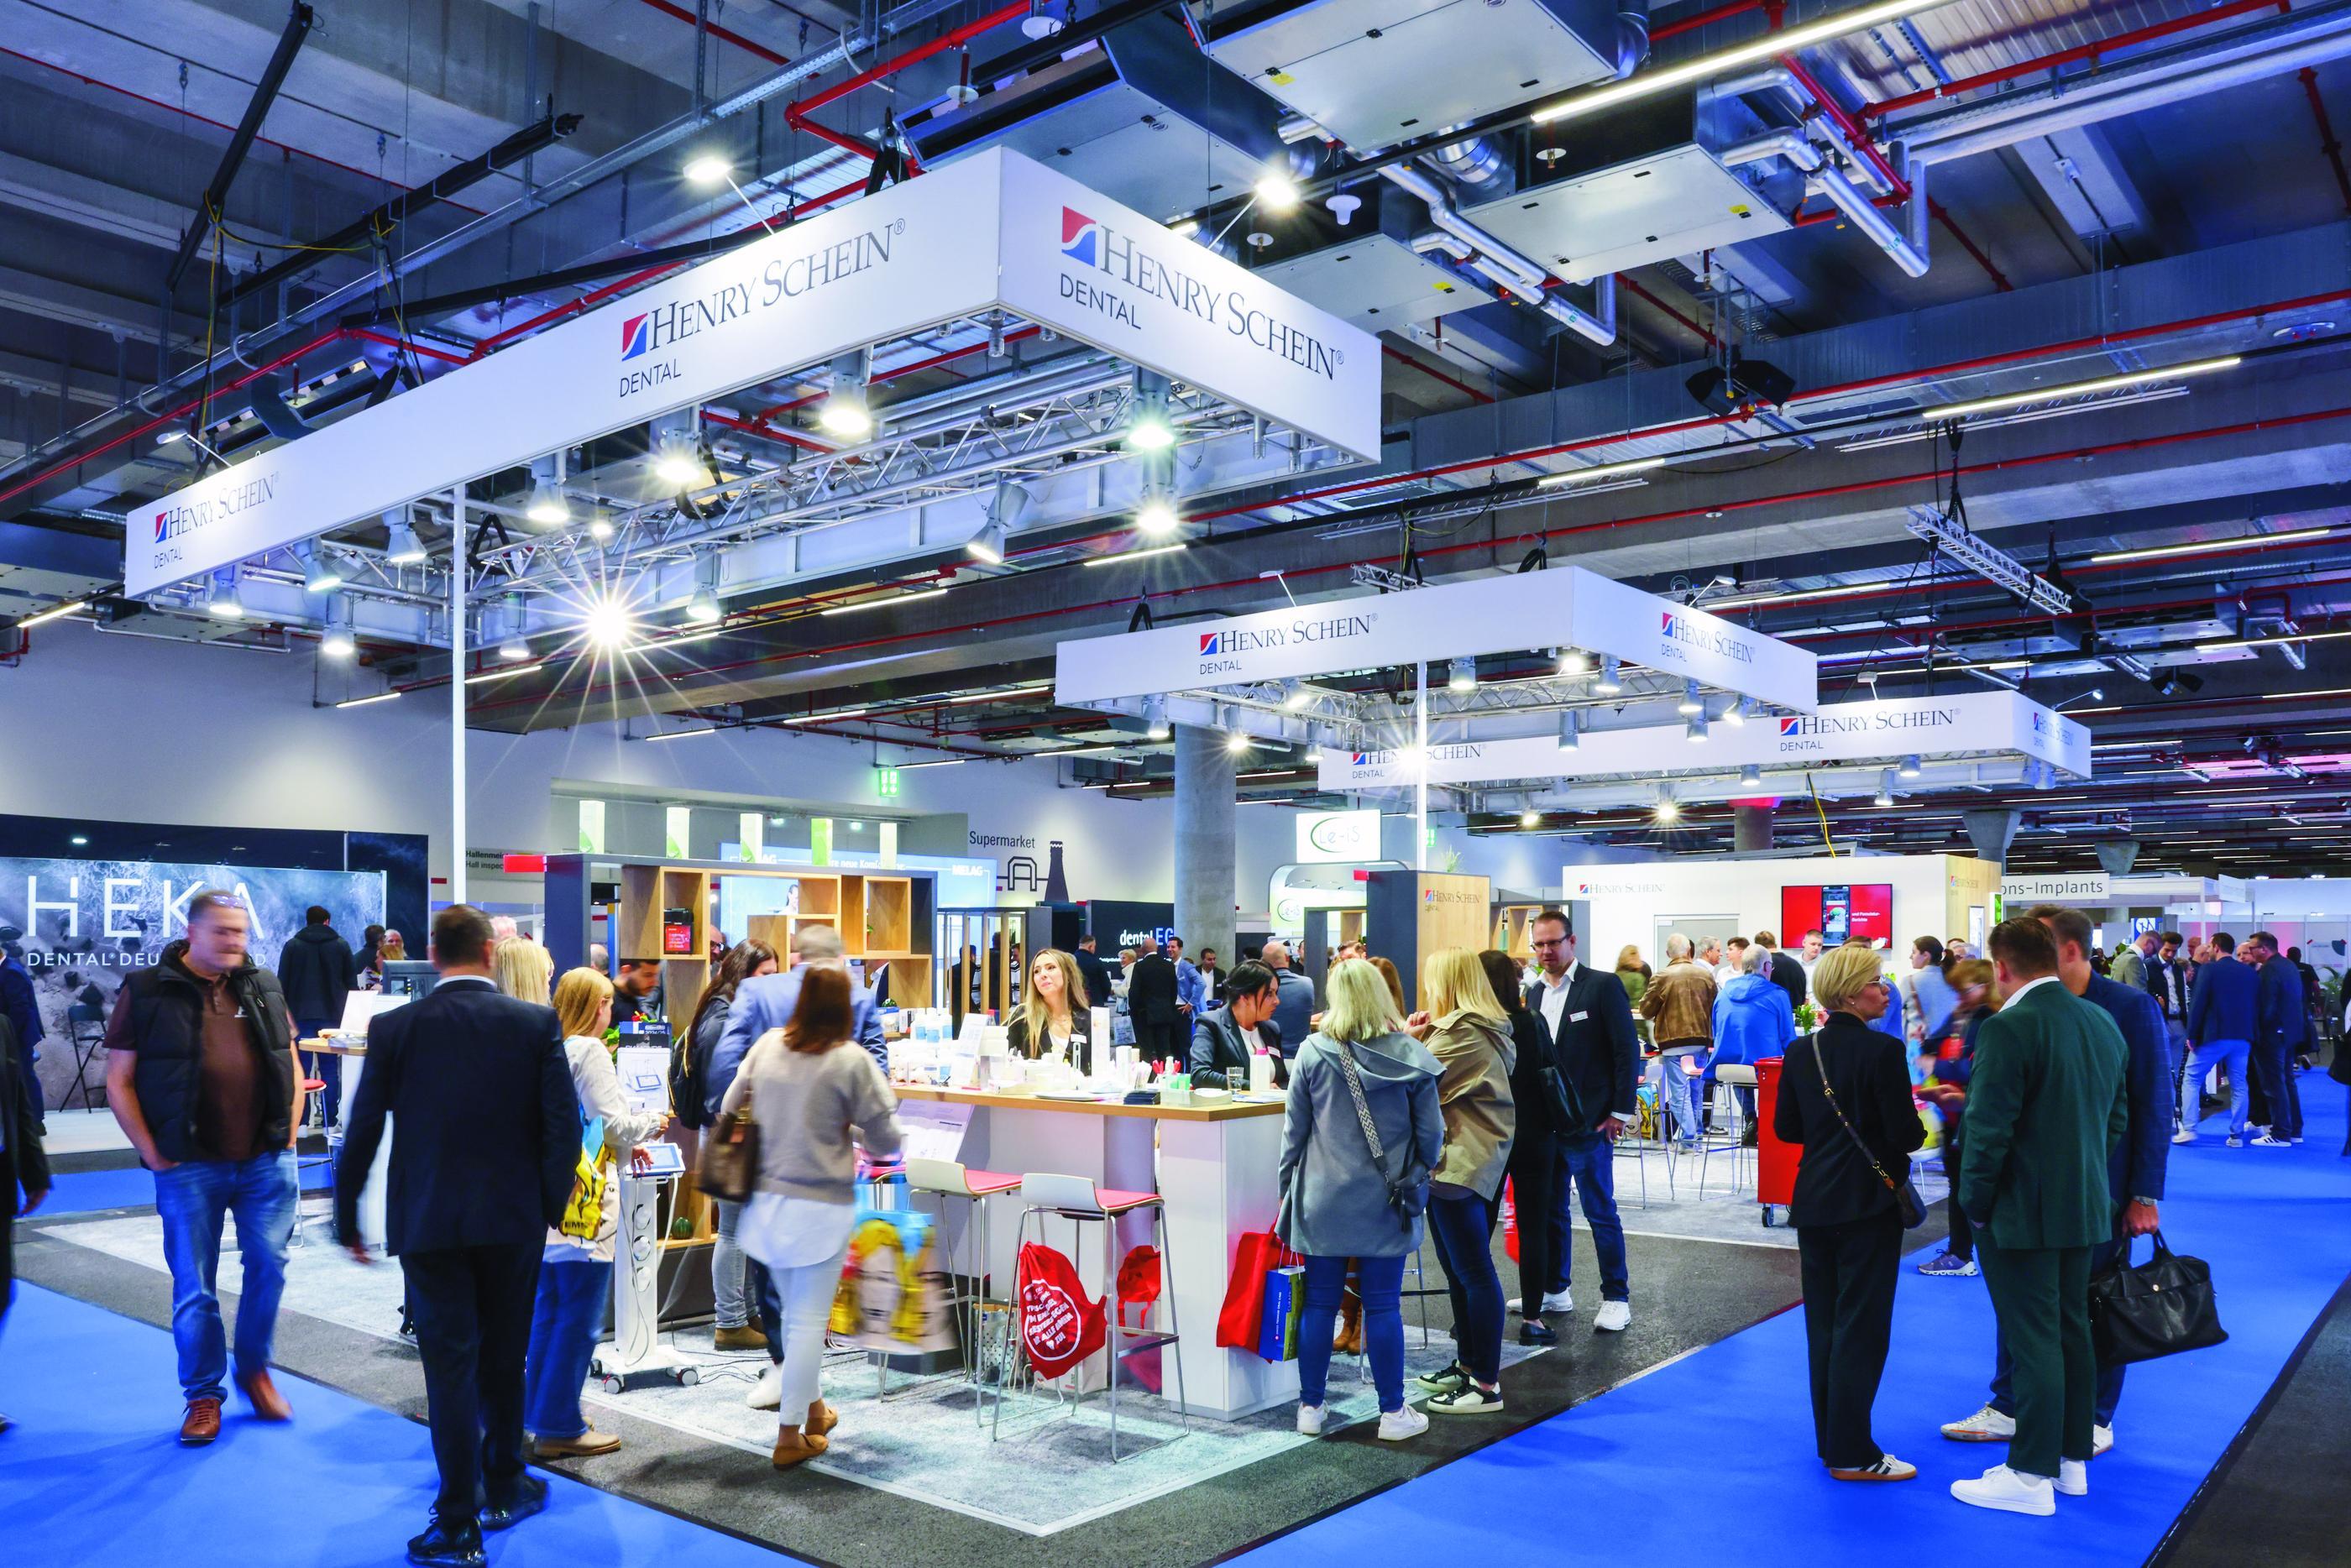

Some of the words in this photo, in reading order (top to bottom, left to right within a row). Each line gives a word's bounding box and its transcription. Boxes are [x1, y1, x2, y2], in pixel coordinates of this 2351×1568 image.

[1101, 225, 1221, 323] HENRY
[1061, 273, 1141, 329] DENTAL
[649, 278, 757, 351] HENRY
[620, 358, 681, 398] DENTAL
[169, 500, 214, 539] HENRY
[154, 548, 183, 569] DENTAL
[1219, 627, 1288, 654] HENRY
[1674, 617, 1712, 650] HENRY
[1662, 644, 1688, 662] DENTAL
[1200, 660, 1242, 675] DENTAL
[1802, 715, 1872, 734] HENRY
[1780, 740, 1825, 751] DENTAL
[1353, 769, 1385, 779] DENTAL
[970, 831, 1035, 849] Supermarket
[466, 850, 505, 859] Hallenmei
[481, 861, 504, 870] inspec
[951, 865, 983, 876] MELAG
[28, 875, 264, 939] HEKA
